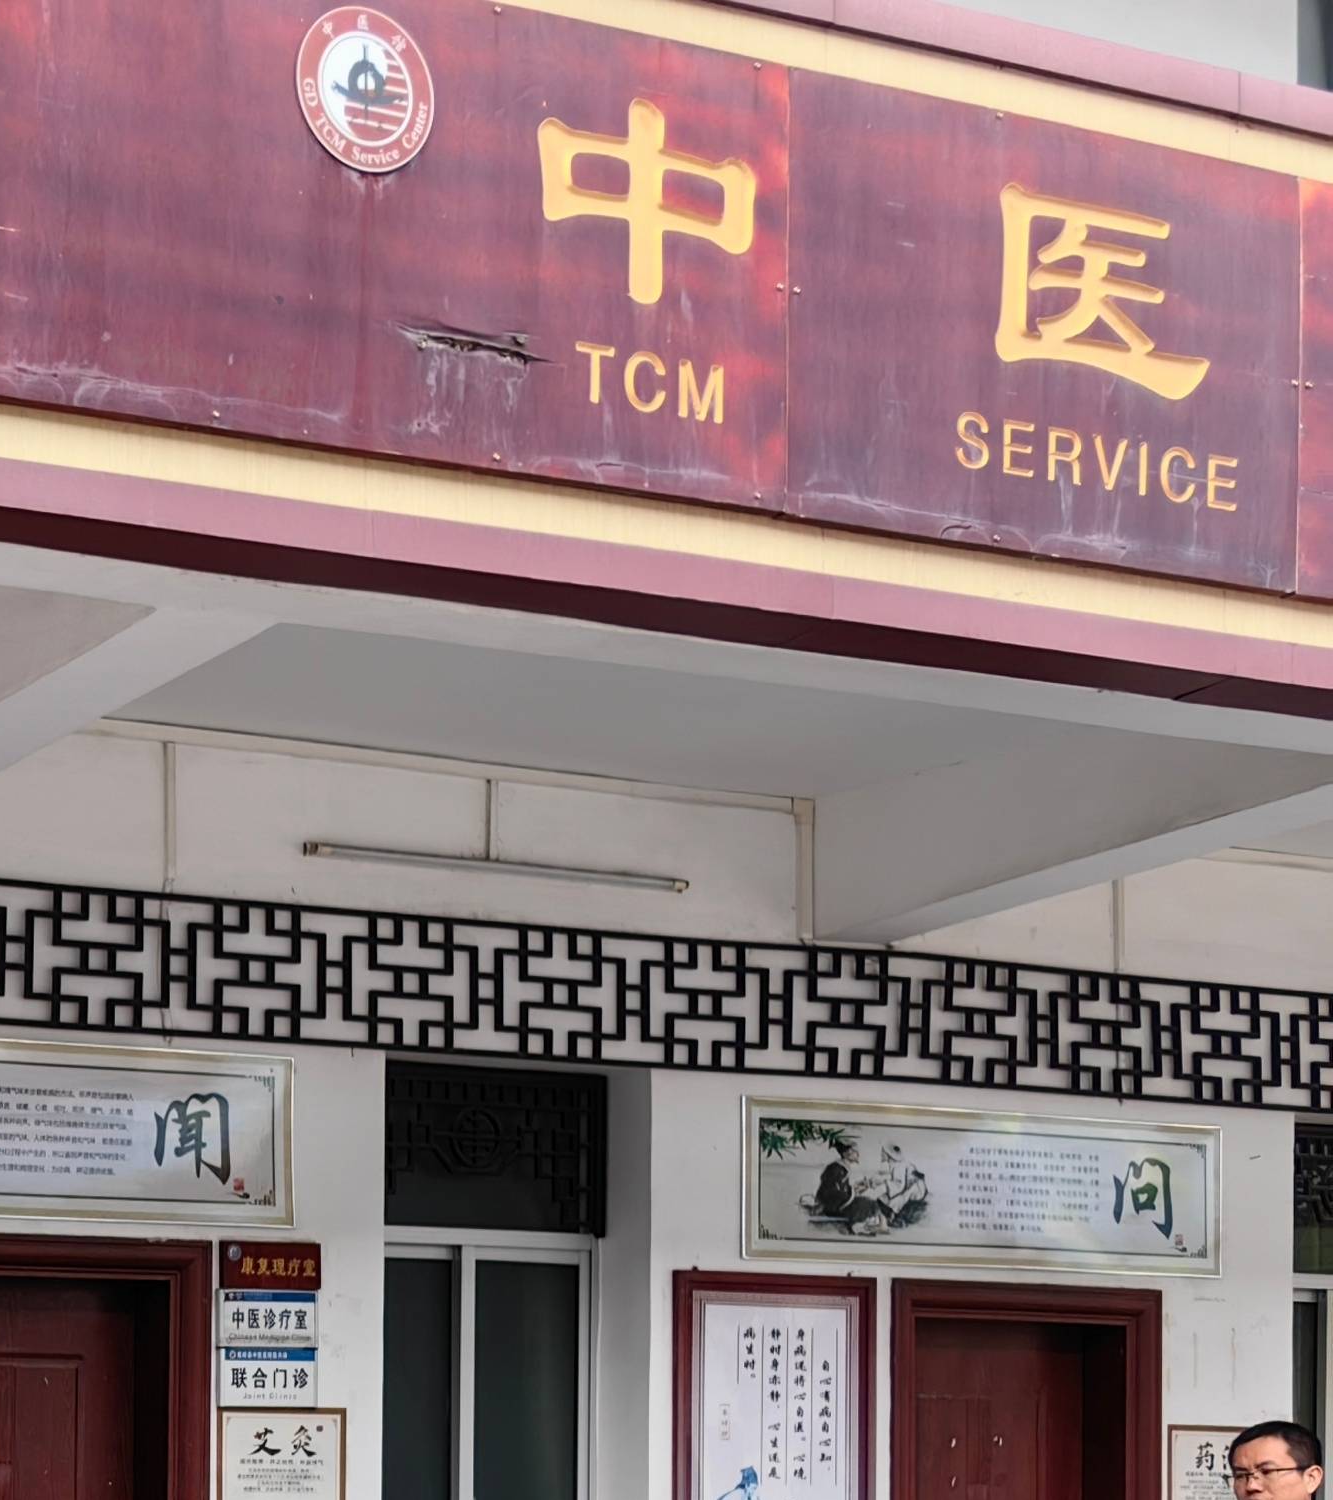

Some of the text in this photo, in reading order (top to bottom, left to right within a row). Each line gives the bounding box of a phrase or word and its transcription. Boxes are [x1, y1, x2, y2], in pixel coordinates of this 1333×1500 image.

[302, 77, 429, 165] GD TCM Service Center
[575, 339, 1239, 513] TCM SERVICE
[232, 1308, 308, 1330] 中医诊疗室
[231, 1367, 309, 1389] 联合门诊
[248, 1425, 317, 1457] 艾灸
